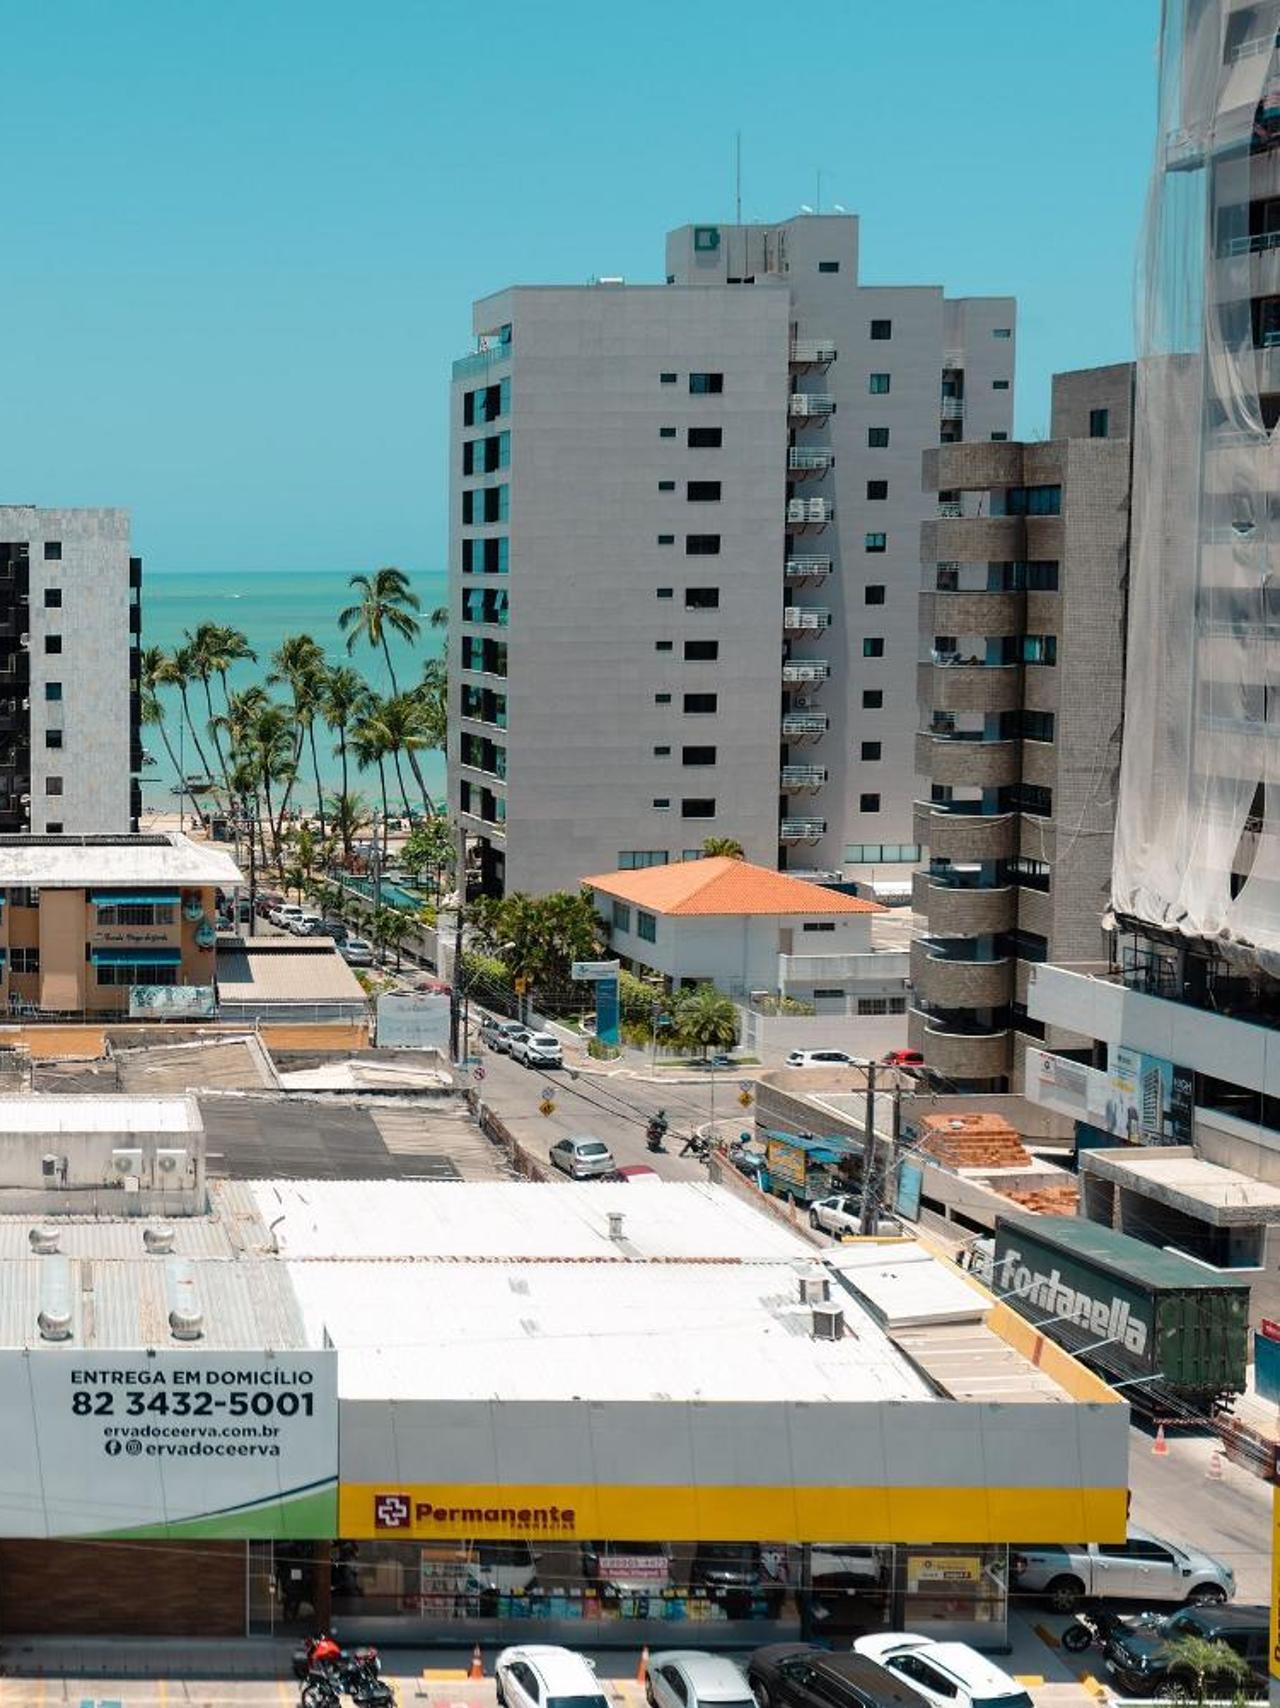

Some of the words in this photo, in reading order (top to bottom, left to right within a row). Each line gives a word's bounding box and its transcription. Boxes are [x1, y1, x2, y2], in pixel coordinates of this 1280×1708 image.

[1001, 1250, 1148, 1355] Fontanella
[71, 1370, 166, 1385] ENTREGA
[173, 1370, 201, 1385] EM
[206, 1368, 314, 1385] DOMICÍLIO
[71, 1391, 114, 1416] 82
[125, 1391, 314, 1417] 3432-5001
[103, 1424, 280, 1438] ervadoceerva.com.br
[145, 1441, 281, 1456] ervadoceerva
[416, 1503, 575, 1523] Permanente
